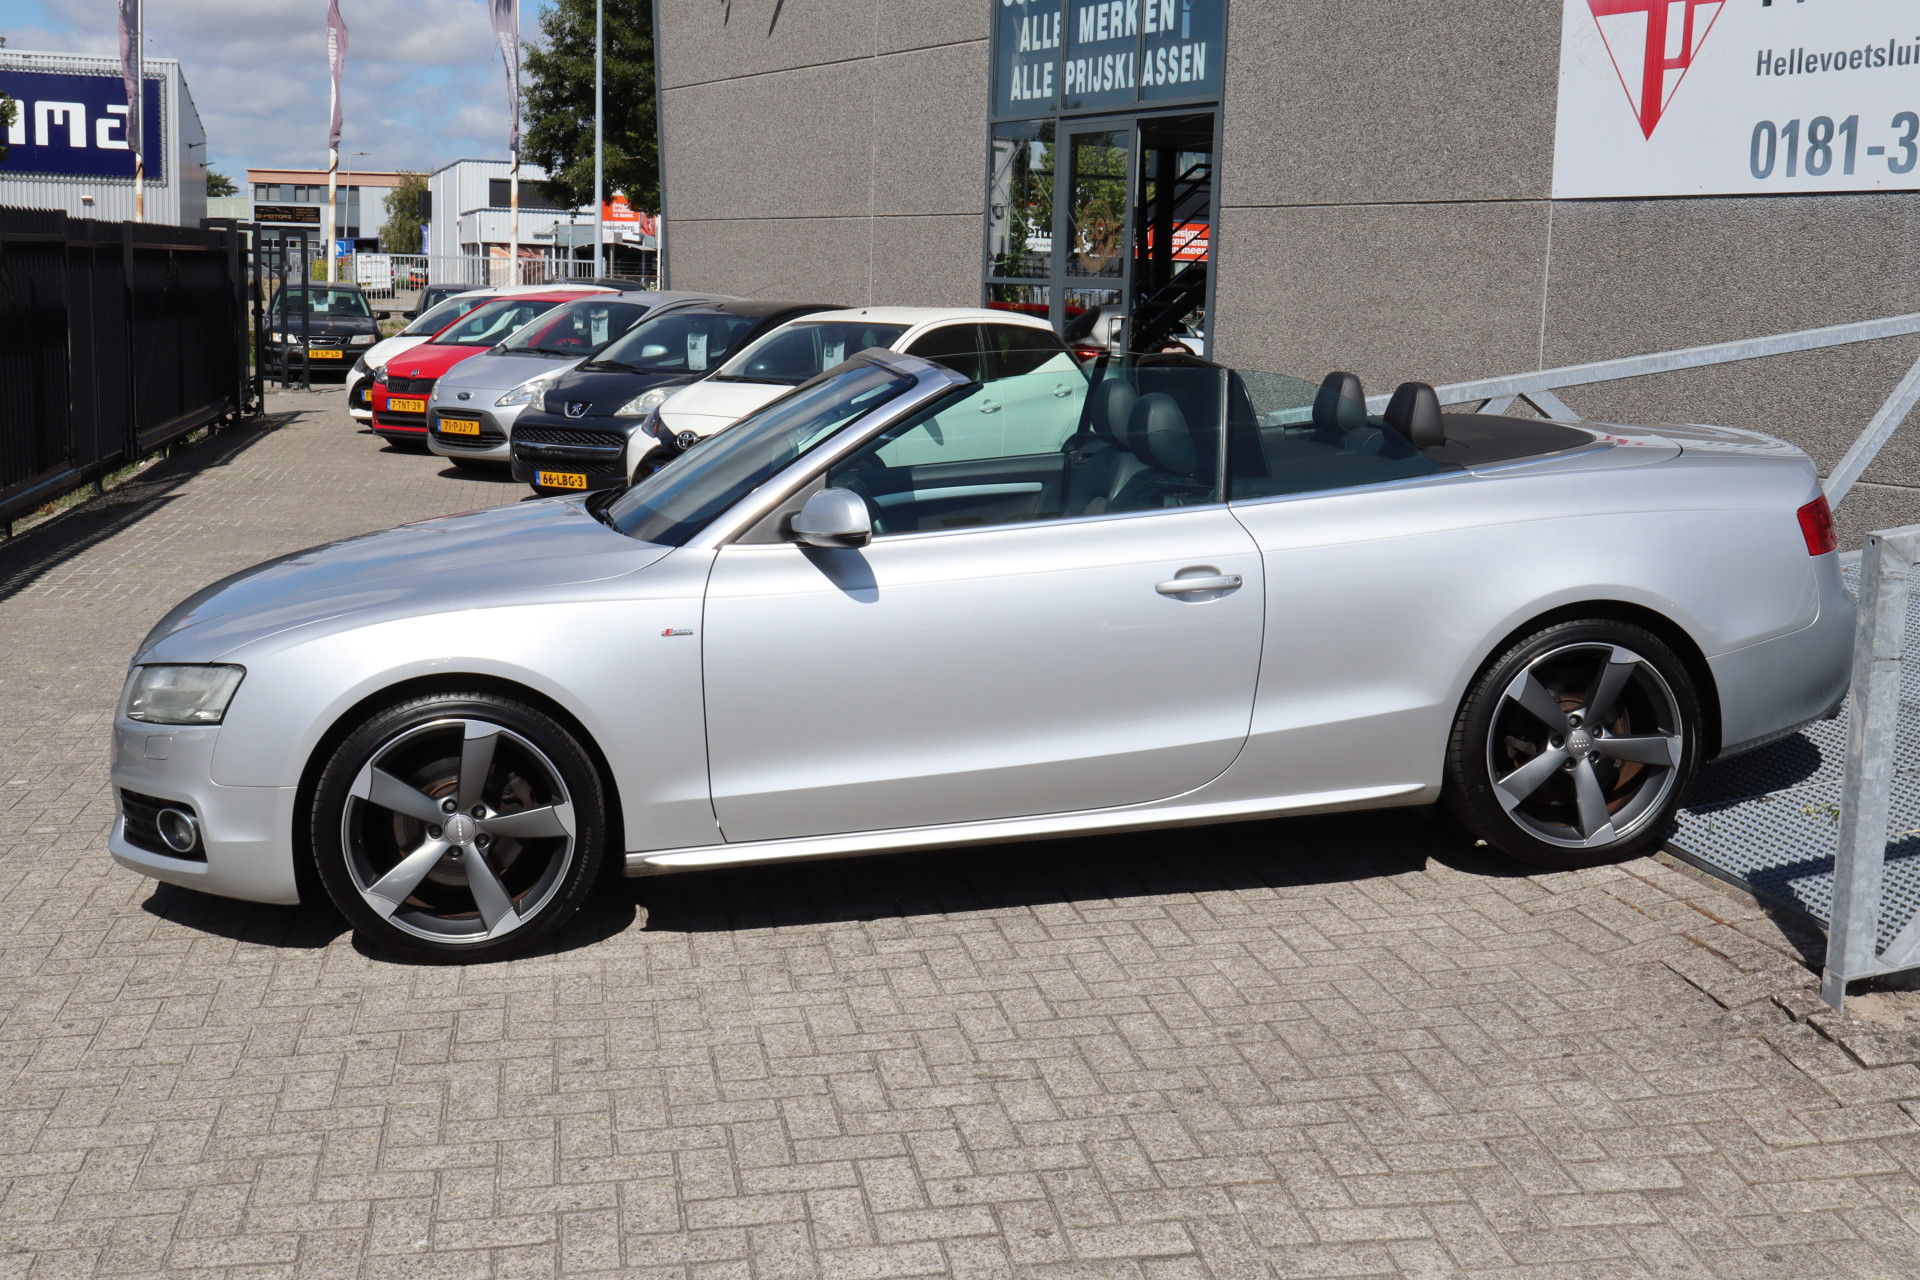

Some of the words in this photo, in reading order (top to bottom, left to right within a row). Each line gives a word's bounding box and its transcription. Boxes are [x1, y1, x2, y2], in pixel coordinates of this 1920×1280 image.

[1019, 11, 1061, 52] ALLE
[1078, 0, 1175, 44] MERKEN
[1010, 62, 1053, 101] ALLE
[1064, 42, 1206, 95] PRIJSKLASSEN
[1756, 36, 1920, 76] Hellevoetslui
[1749, 111, 1920, 180] 0181-3
[391, 400, 421, 411] 7-TNT-39
[444, 420, 474, 433] 71-PJJ-7
[543, 473, 584, 487] 66-LBG-3
